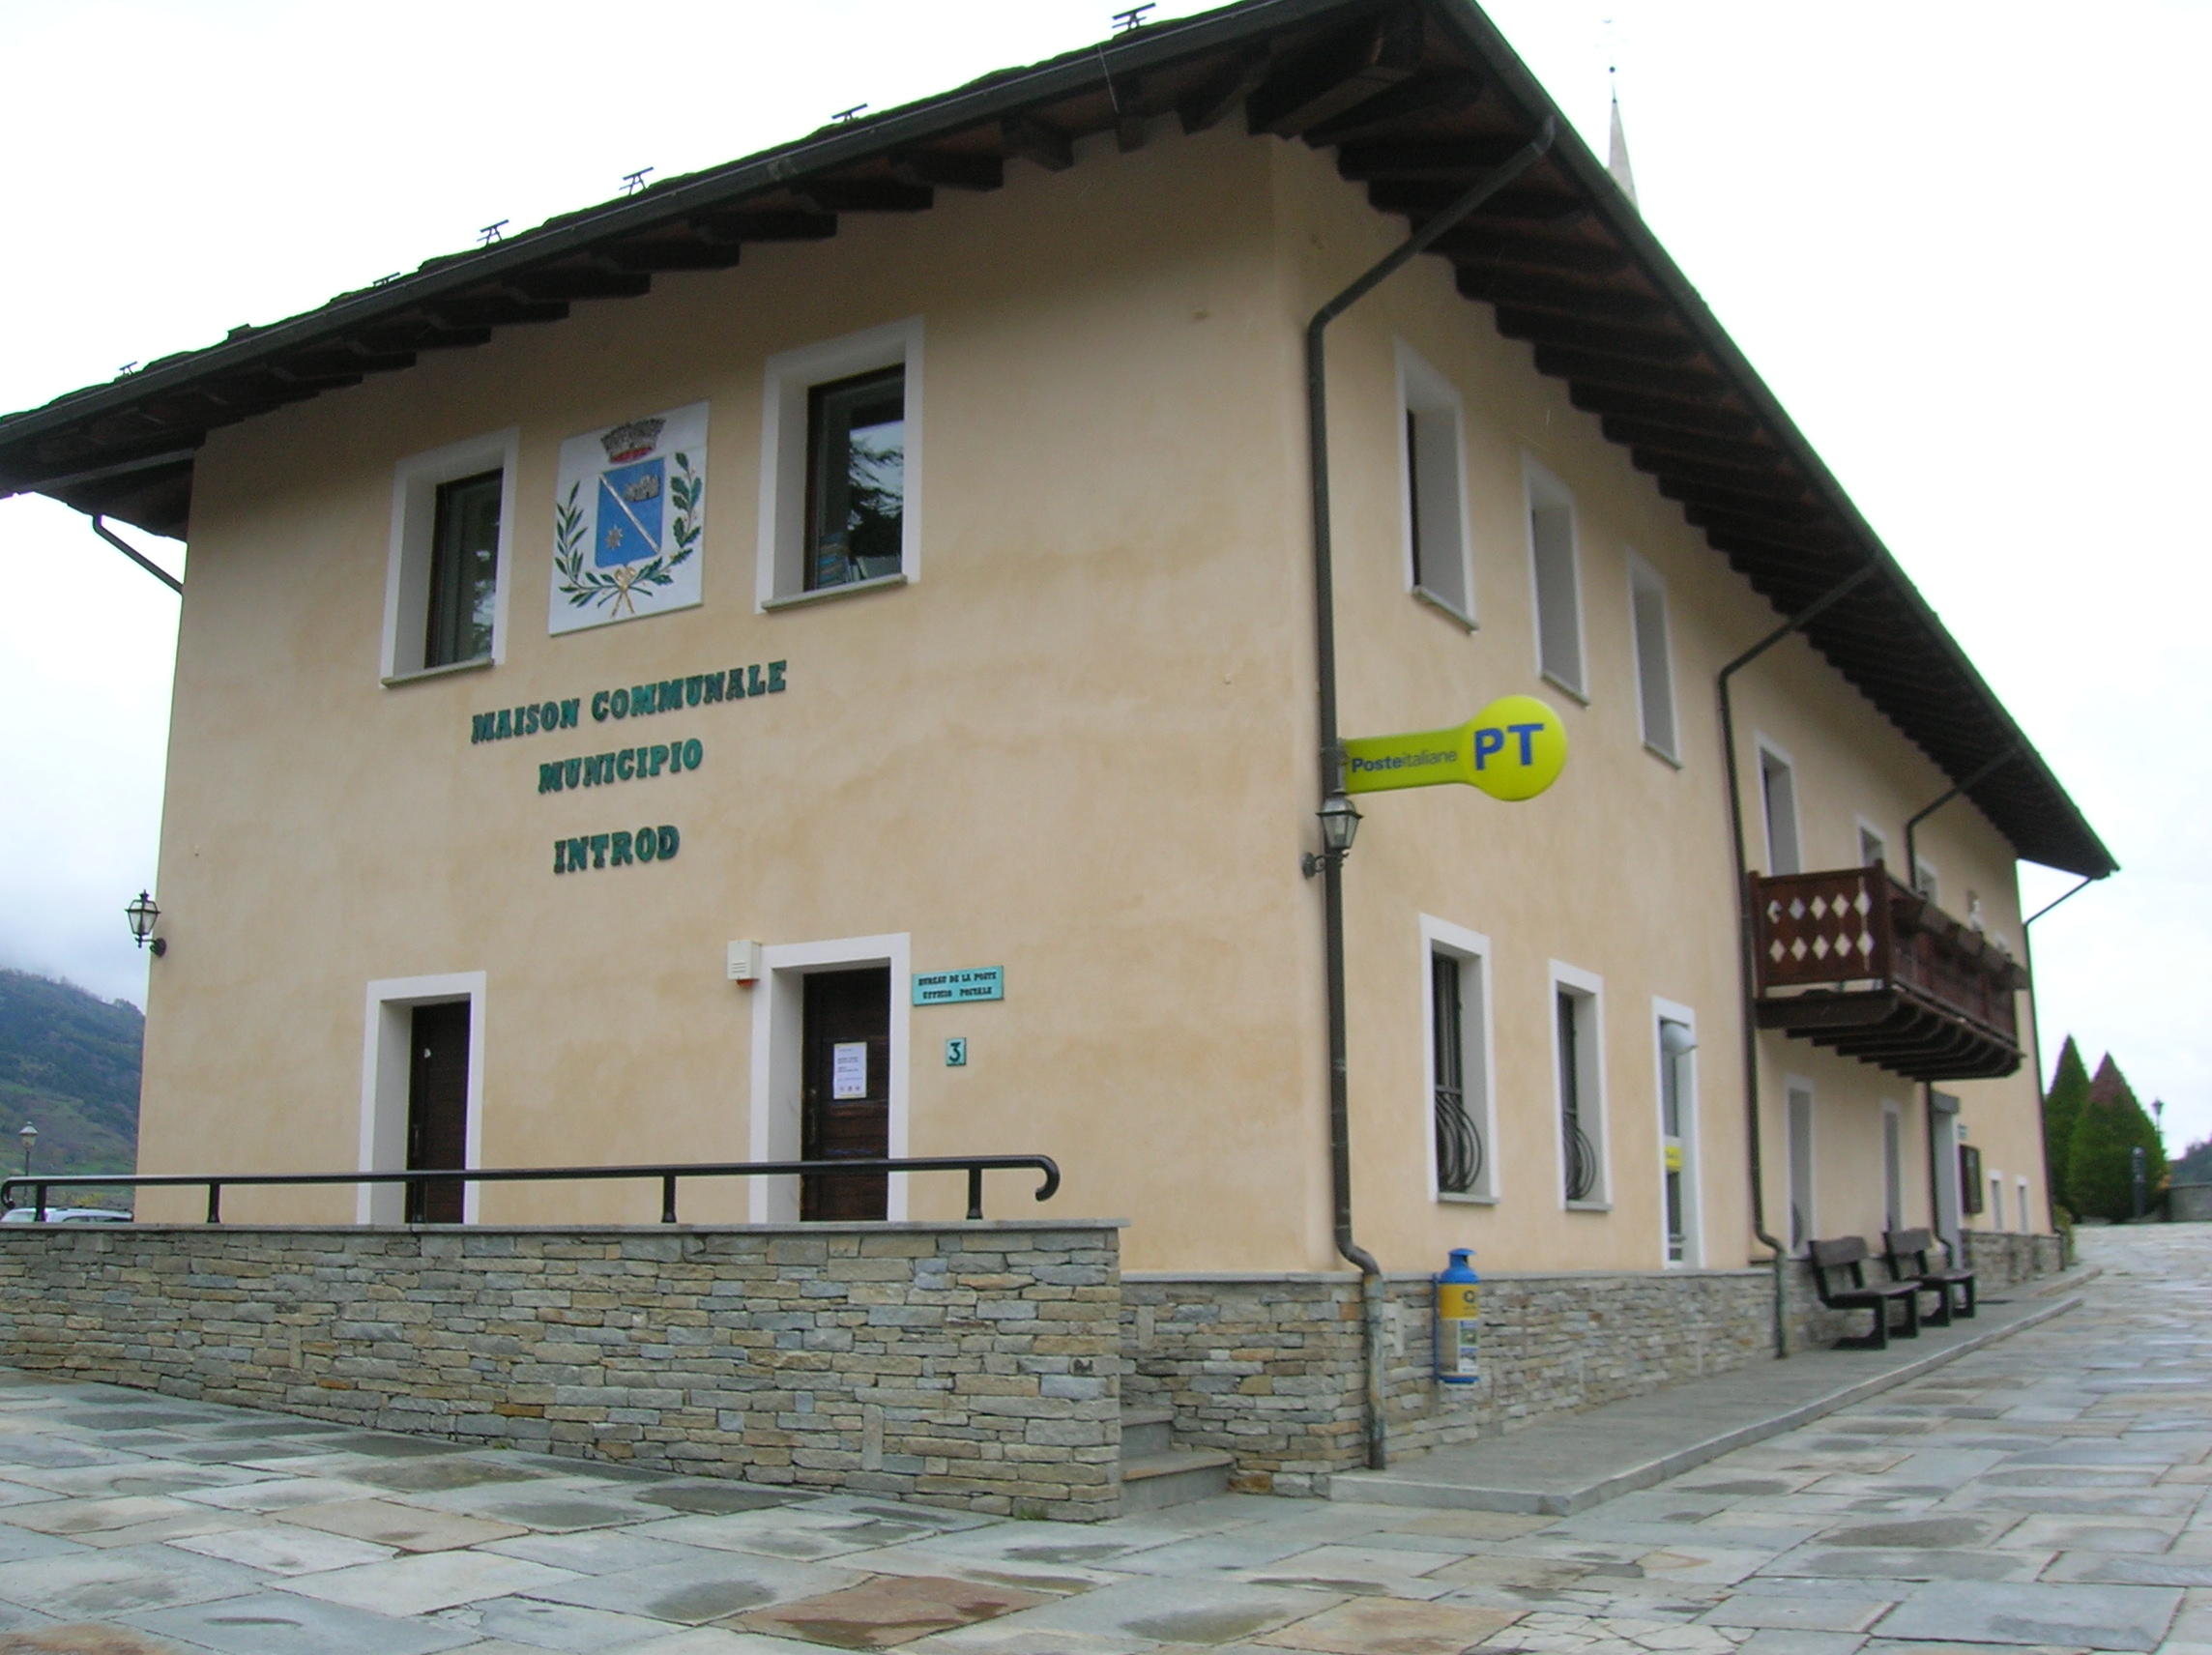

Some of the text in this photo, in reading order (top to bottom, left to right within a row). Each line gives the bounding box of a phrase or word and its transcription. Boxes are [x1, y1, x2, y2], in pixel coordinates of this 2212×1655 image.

[471, 659, 788, 743] MAISON COMMUNALE
[538, 738, 704, 795] MUNICIPIO
[1473, 723, 1544, 770] PT
[553, 825, 681, 874] INTROD
[949, 974, 959, 983] DE
[962, 973, 972, 982] LA
[948, 1041, 962, 1062] 3
